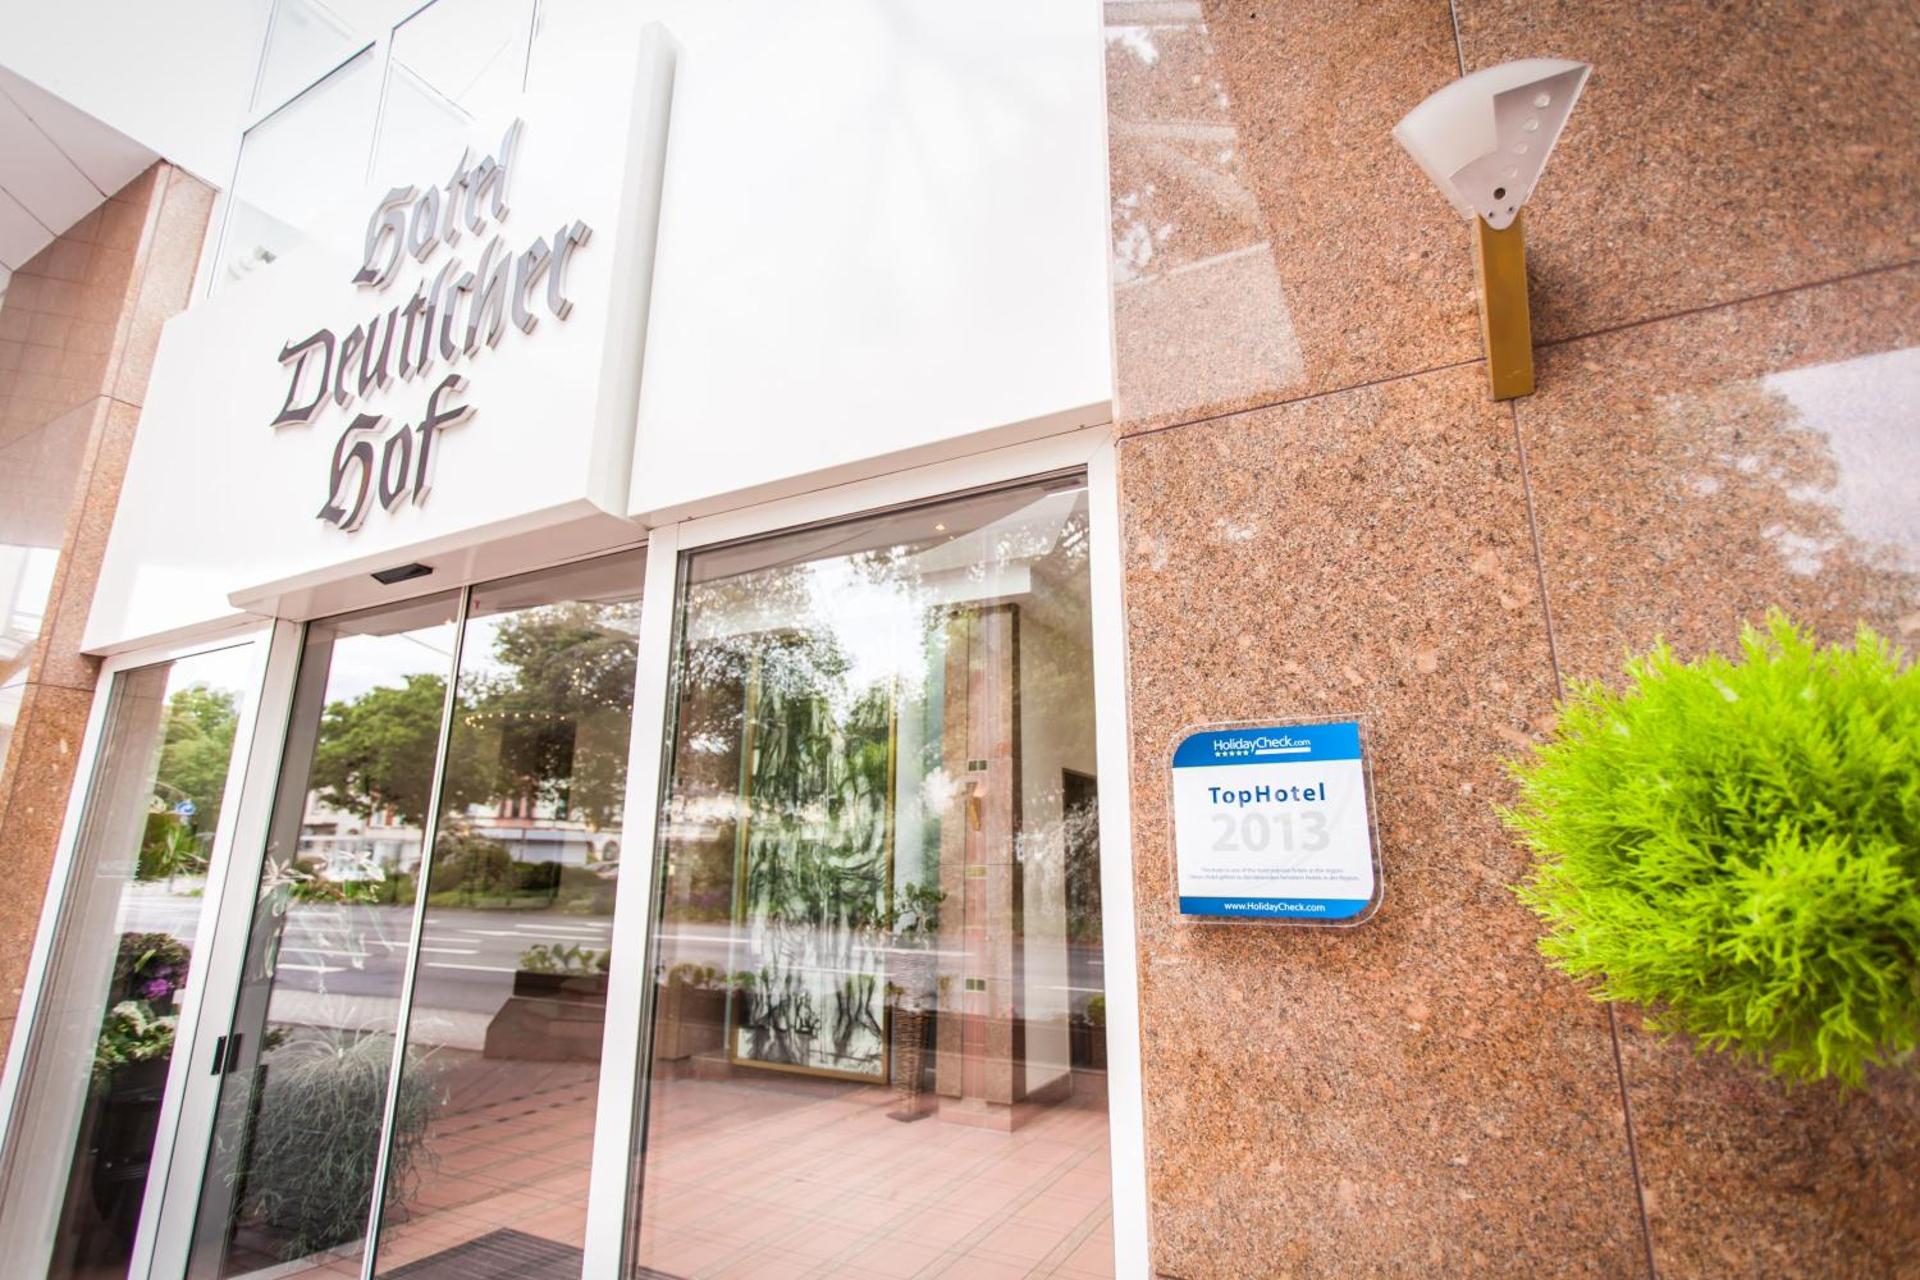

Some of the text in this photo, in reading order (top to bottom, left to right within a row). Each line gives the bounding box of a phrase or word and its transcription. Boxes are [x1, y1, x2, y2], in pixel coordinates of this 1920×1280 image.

[352, 117, 524, 292] Hotel
[316, 373, 478, 533] Hof
[1213, 735, 1311, 753] HolidayCheck.com
[1208, 782, 1325, 808] TopHotel
[1211, 811, 1331, 852] 2013
[1224, 901, 1326, 913] www.HolidayCheck.com
